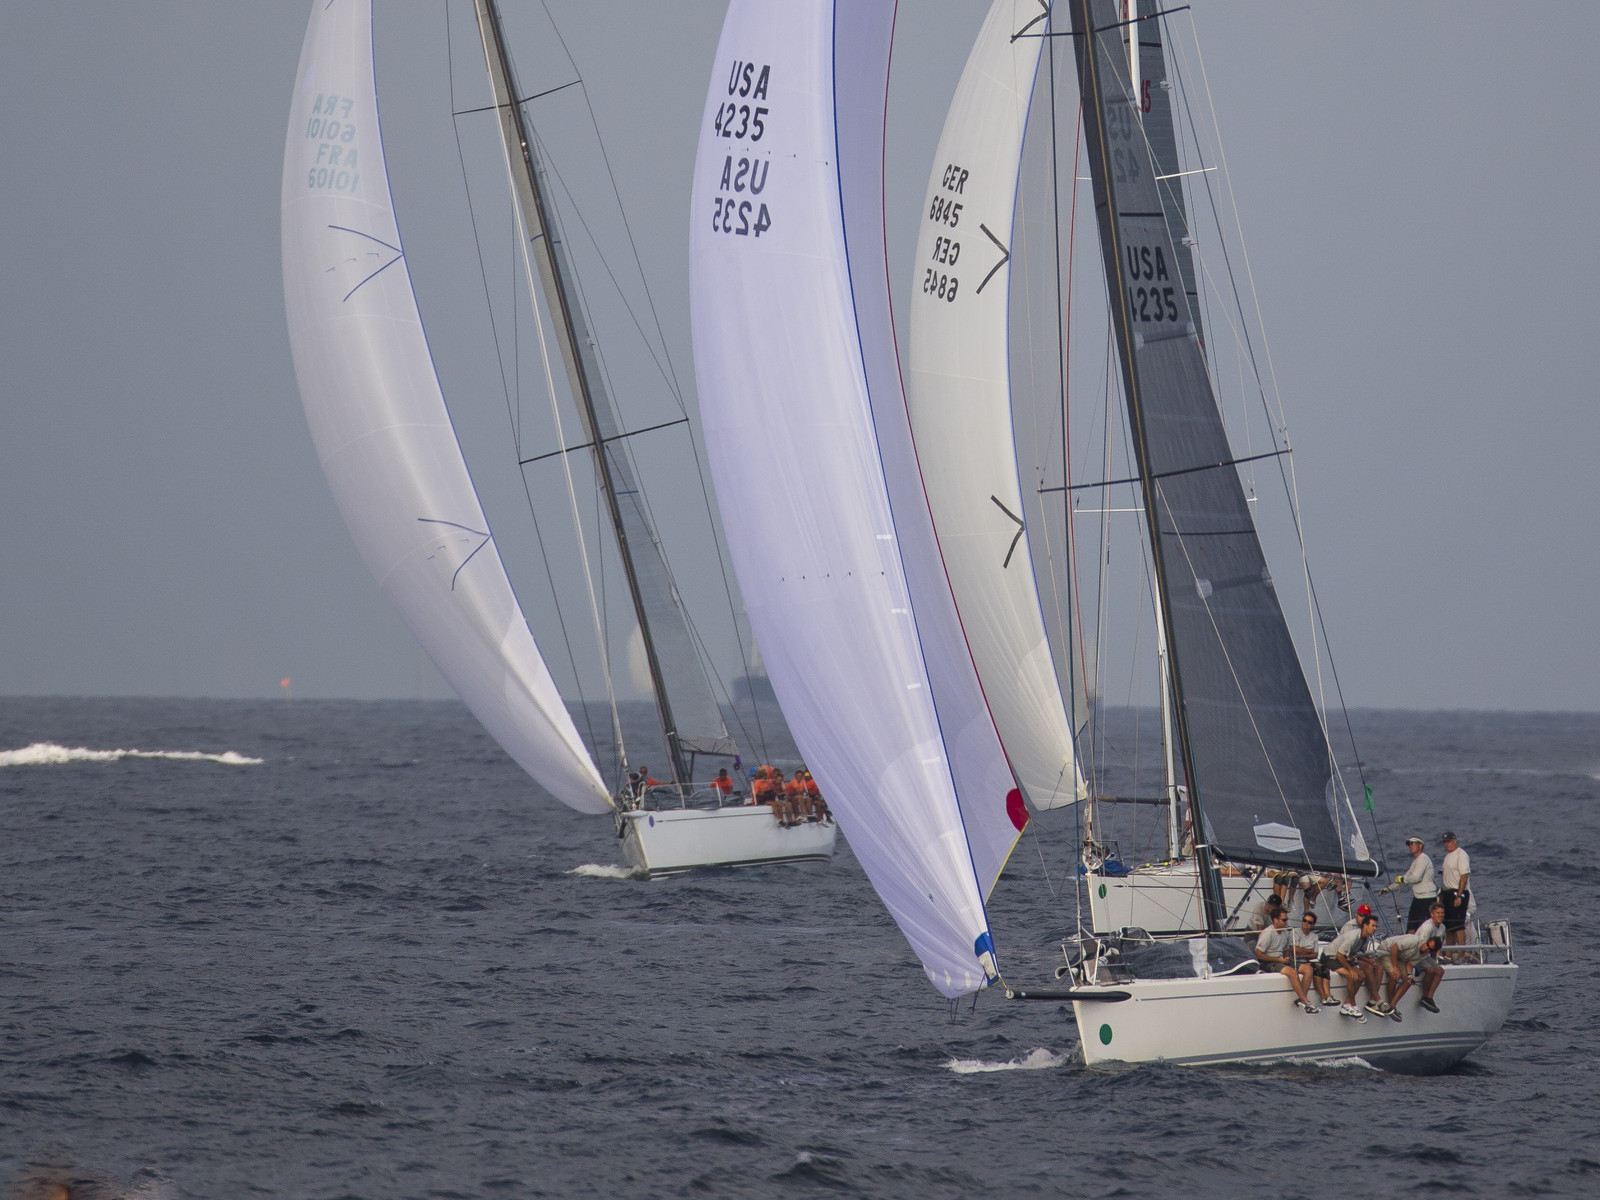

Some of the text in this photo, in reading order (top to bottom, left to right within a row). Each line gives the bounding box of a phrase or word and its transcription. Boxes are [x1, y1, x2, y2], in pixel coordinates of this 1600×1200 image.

[729, 60, 770, 100] USA
[715, 102, 768, 141] 4235
[317, 143, 358, 169] FRA
[308, 167, 360, 193] 60101
[942, 164, 969, 194] GER
[929, 195, 963, 228] 6845
[1127, 245, 1169, 281] USA
